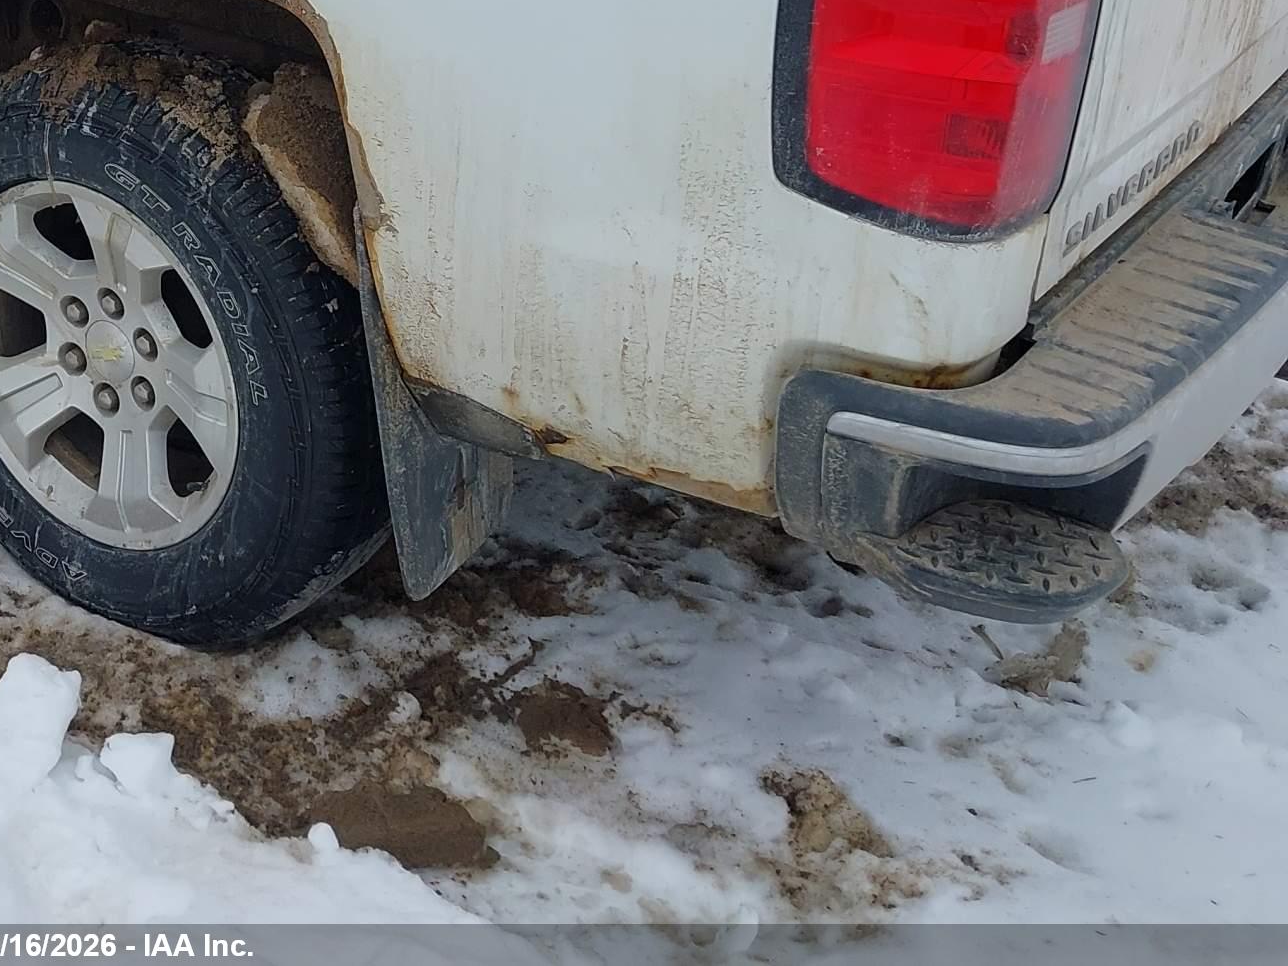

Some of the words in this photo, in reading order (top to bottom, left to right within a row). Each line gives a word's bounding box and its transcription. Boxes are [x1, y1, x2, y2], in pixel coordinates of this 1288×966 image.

[104, 162, 172, 213] GT
[171, 220, 269, 407] RADIAL
[1063, 120, 1202, 258] SILVERADO
